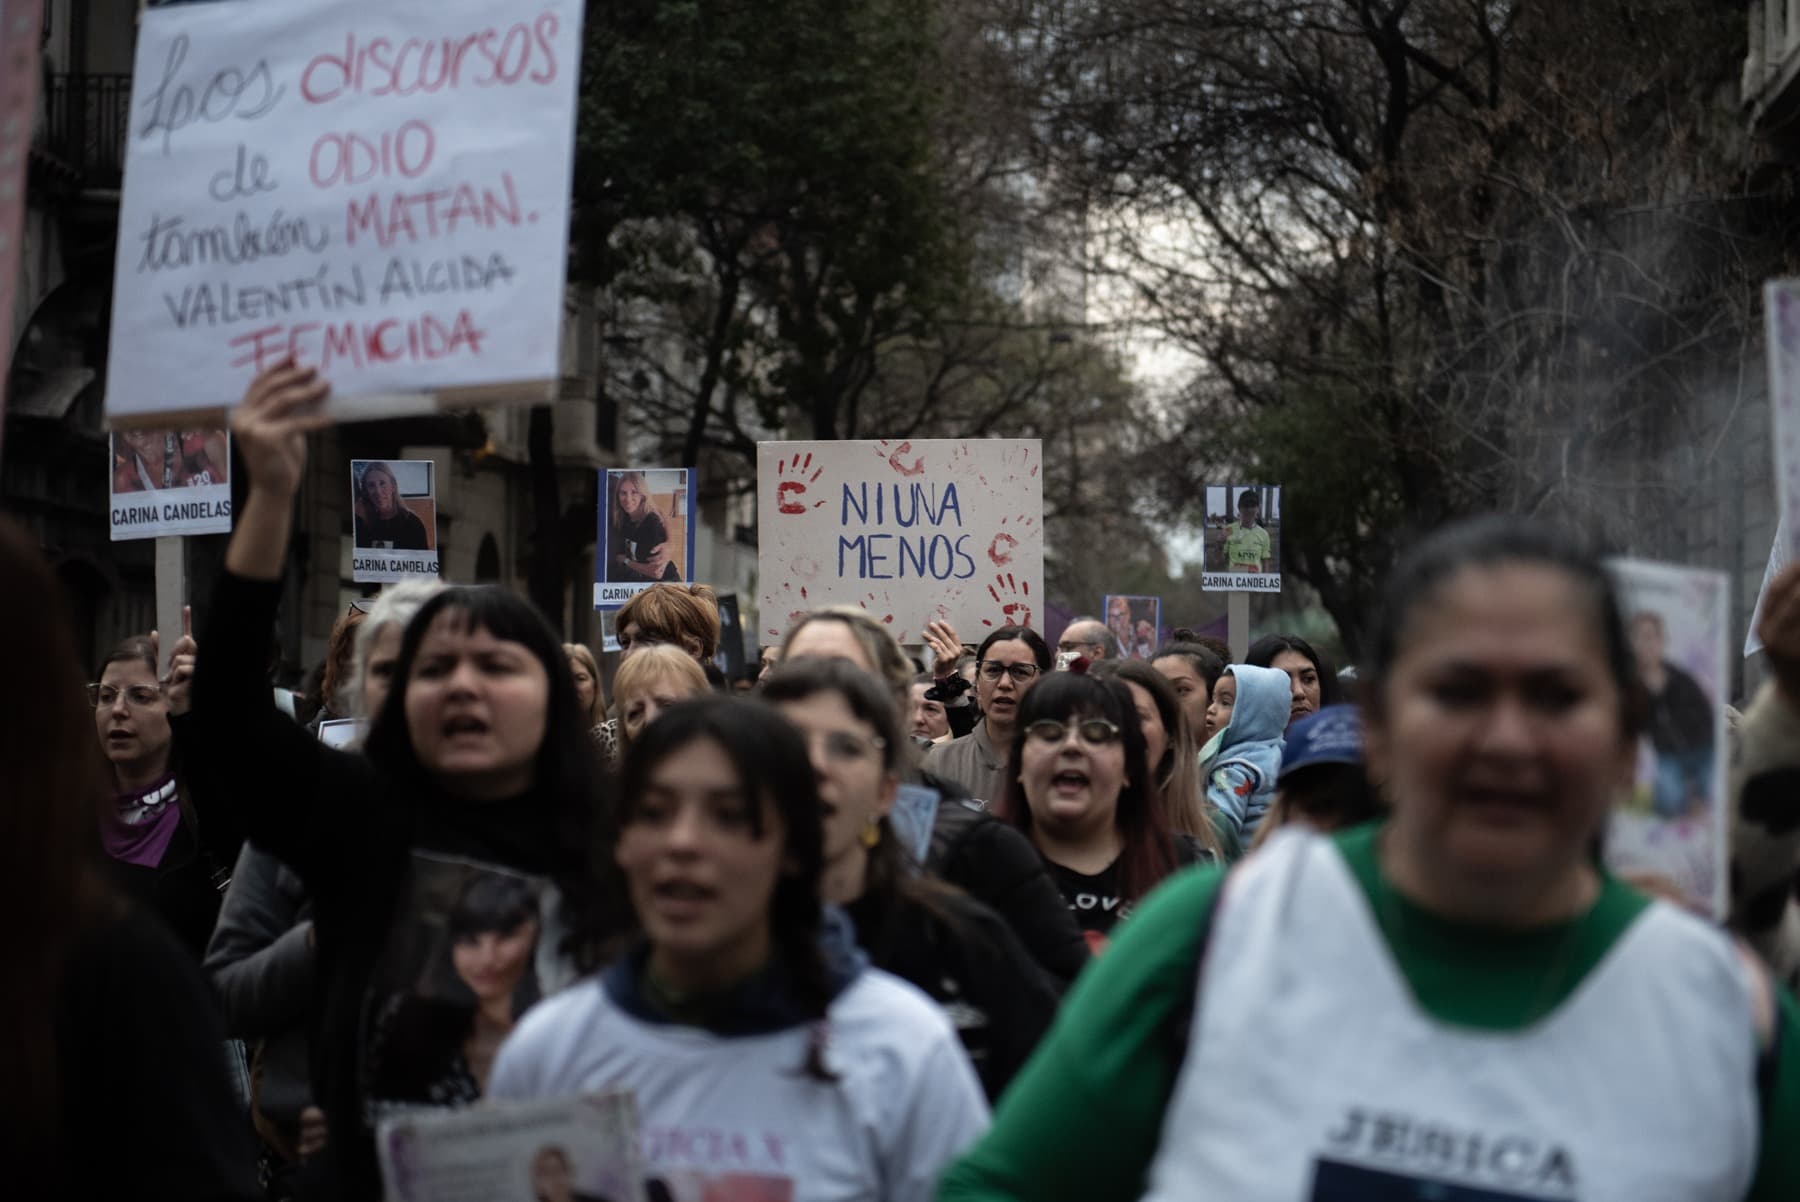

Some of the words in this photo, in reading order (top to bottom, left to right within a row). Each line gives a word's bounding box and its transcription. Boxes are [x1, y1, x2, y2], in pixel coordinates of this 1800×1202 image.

[300, 11, 559, 104] discursos
[208, 144, 280, 201] de
[309, 119, 435, 189] ODIO
[346, 173, 540, 248] MATAN.
[163, 262, 366, 328] VALENTÍN
[228, 308, 489, 373] FEMICIDA
[112, 505, 159, 526] CARINA
[163, 500, 231, 521] CANDELAS
[841, 481, 883, 527] NI
[893, 481, 963, 528] UNA
[353, 559, 387, 572] CARINA
[390, 560, 440, 573] CANDELAS
[837, 533, 976, 581] MENOS
[1202, 576, 1233, 588] CARINA
[1236, 577, 1280, 588] CANDELAS
